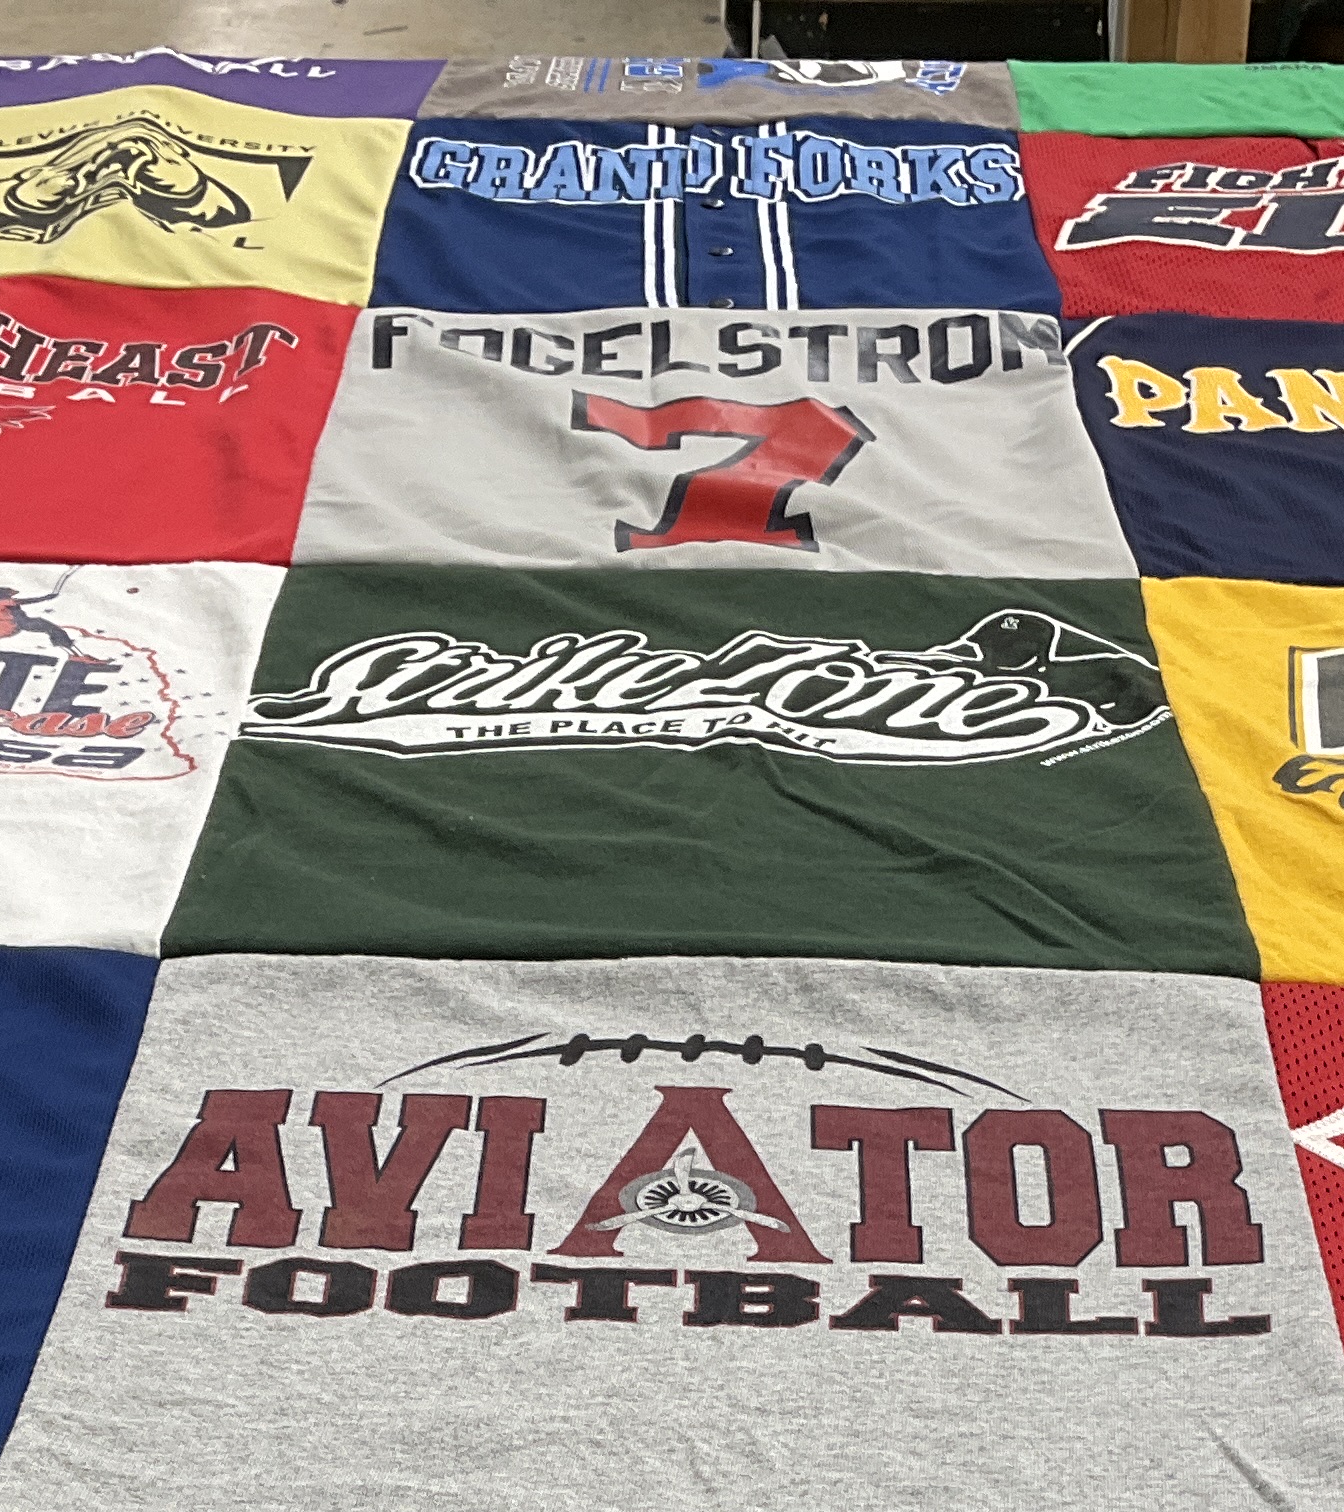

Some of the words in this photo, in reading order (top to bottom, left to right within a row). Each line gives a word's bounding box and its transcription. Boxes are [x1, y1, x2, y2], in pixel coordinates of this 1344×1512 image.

[410, 135, 723, 205] GRAND
[729, 129, 1025, 206] FORKS
[370, 312, 1067, 385] FOGELSTROM
[570, 388, 877, 553] 7
[446, 722, 532, 739] THE
[549, 718, 686, 736] PLACE
[702, 710, 754, 735] TO
[766, 720, 837, 748] HIT
[120, 1084, 1268, 1268] AVIATOR
[104, 1251, 1272, 1337] FOOTBALL
